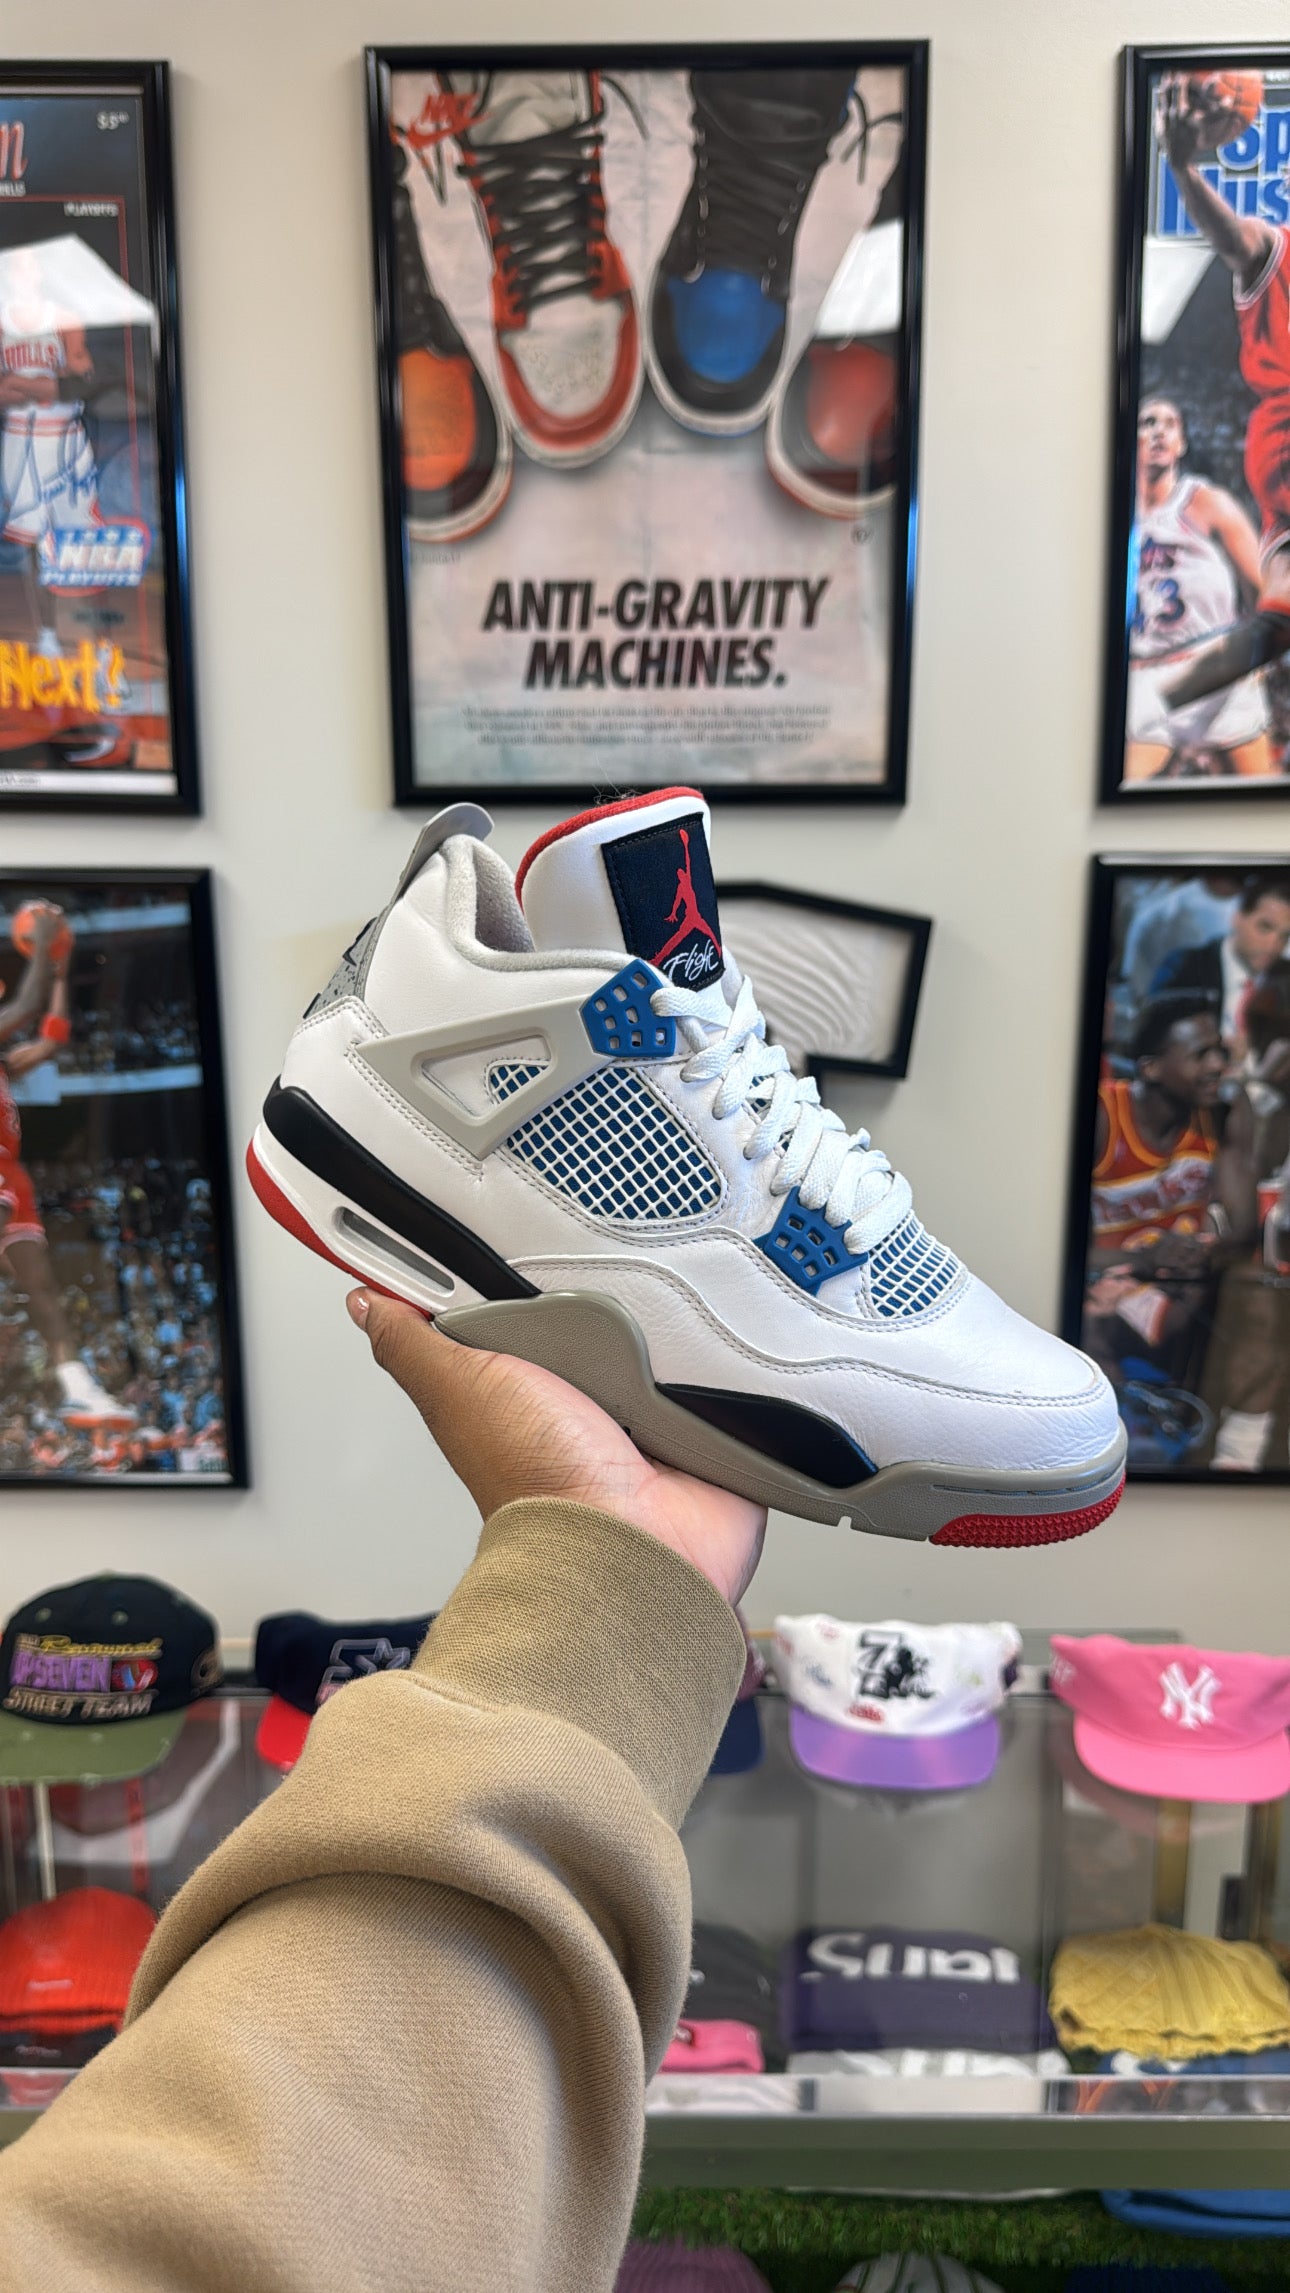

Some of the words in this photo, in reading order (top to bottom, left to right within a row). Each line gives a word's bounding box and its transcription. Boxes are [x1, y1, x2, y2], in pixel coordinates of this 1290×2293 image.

[481, 578, 831, 632] ANTI-GRAVITY
[523, 636, 788, 690] MACHINES.
[662, 938, 720, 982] Flight
[1159, 1662, 1222, 1730] NY
